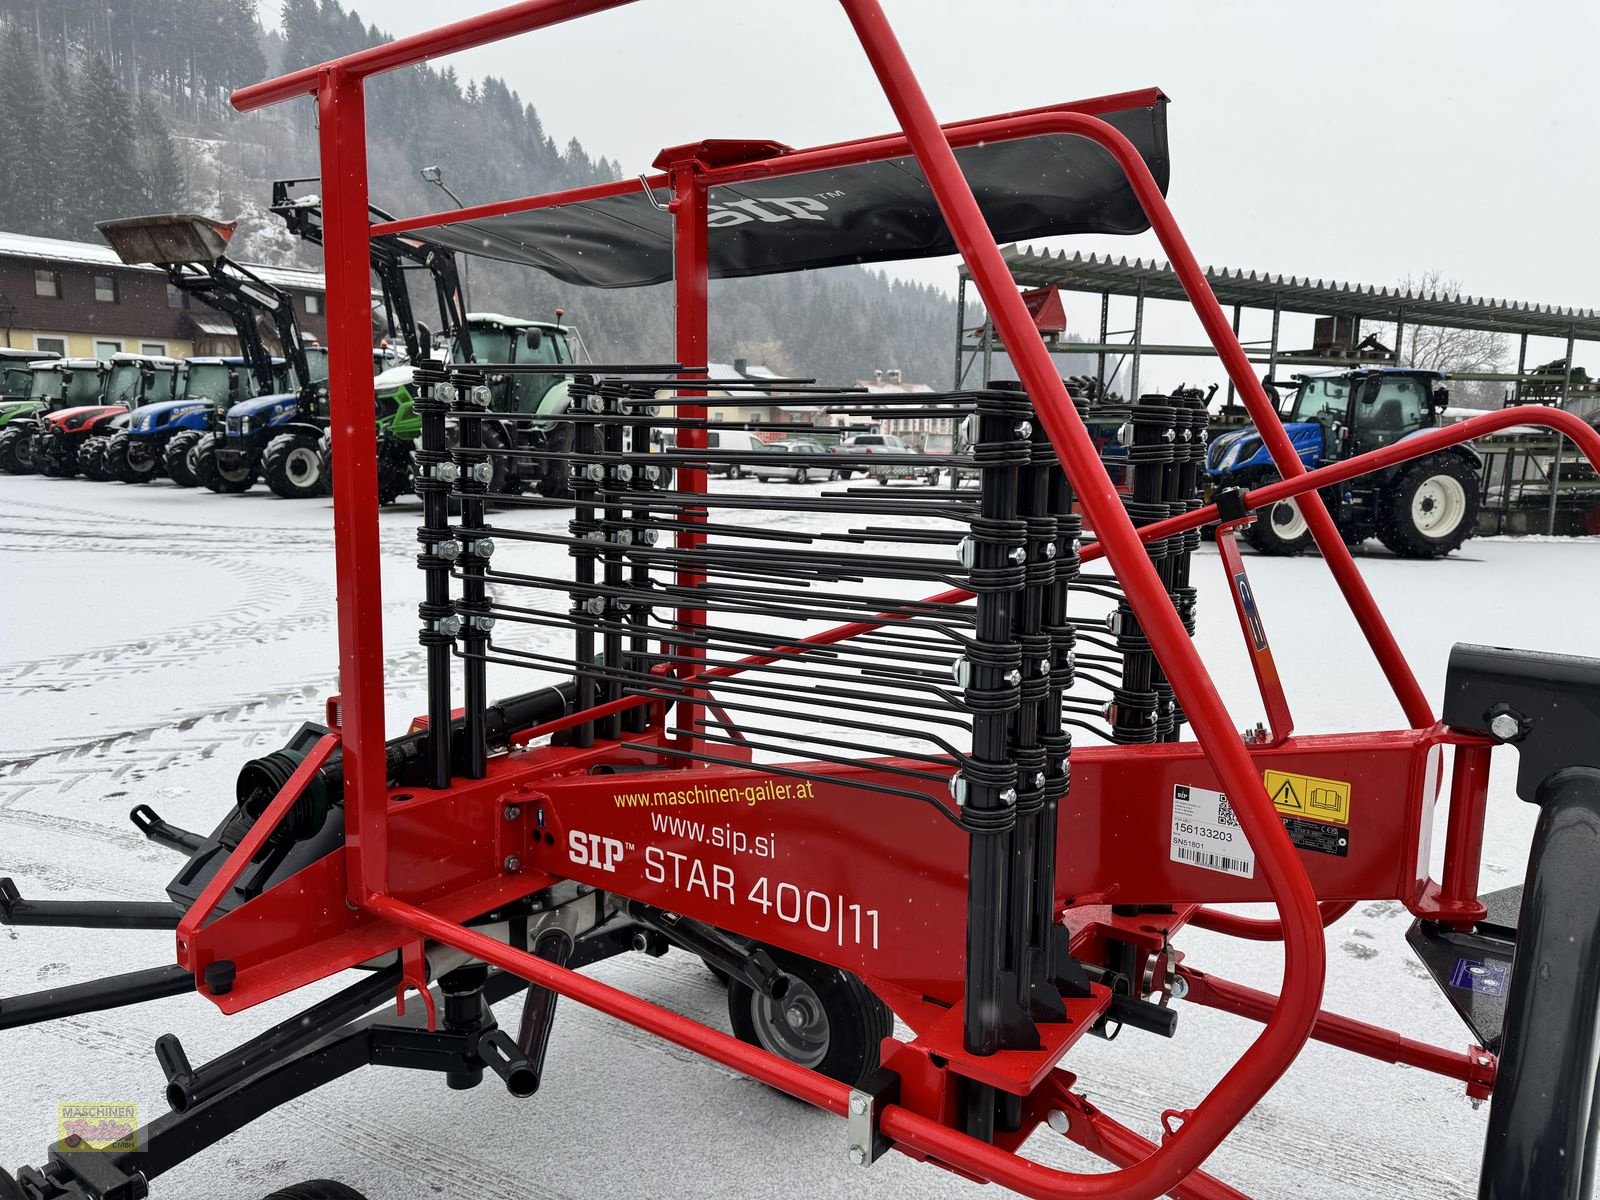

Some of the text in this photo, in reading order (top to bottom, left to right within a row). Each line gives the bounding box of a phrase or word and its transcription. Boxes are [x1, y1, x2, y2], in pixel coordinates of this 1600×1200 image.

[613, 780, 815, 808] www.maschinen-gailer.at
[651, 812, 776, 860] www.sip.si
[1173, 837, 1204, 850] SN51801
[1174, 822, 1233, 843] 156133203
[645, 846, 735, 905] STAR
[747, 876, 879, 950] 400|11
